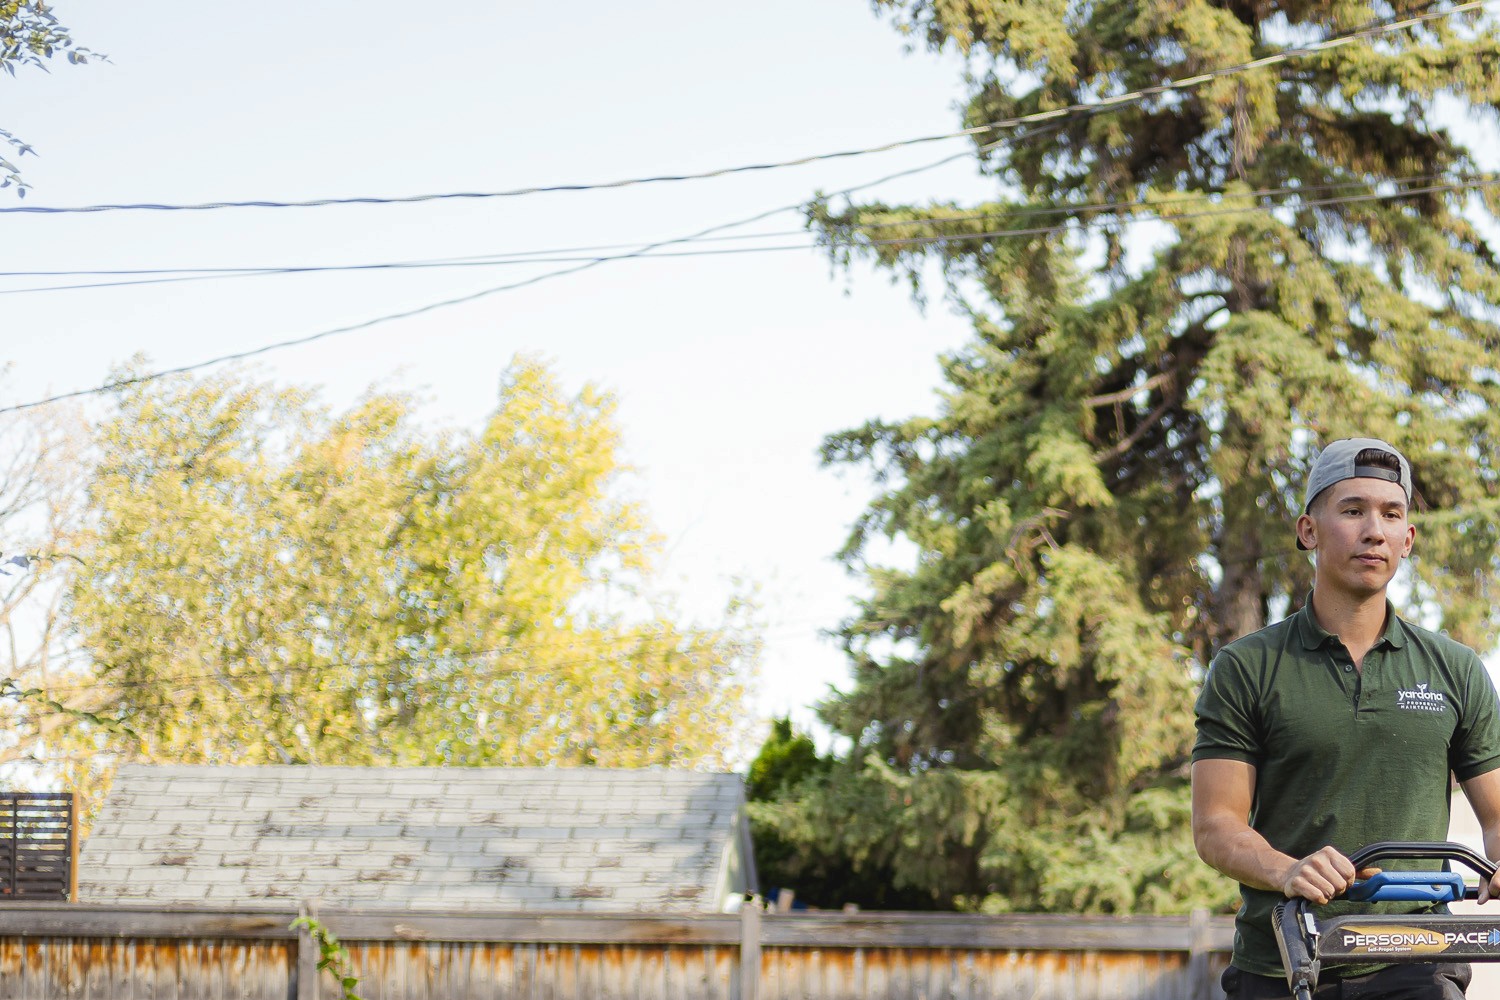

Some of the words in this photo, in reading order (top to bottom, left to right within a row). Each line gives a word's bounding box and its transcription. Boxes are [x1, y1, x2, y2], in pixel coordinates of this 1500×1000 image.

[1398, 688, 1443, 701] yardona
[1343, 934, 1438, 946] PERSONAL
[1444, 932, 1489, 944] PACE
